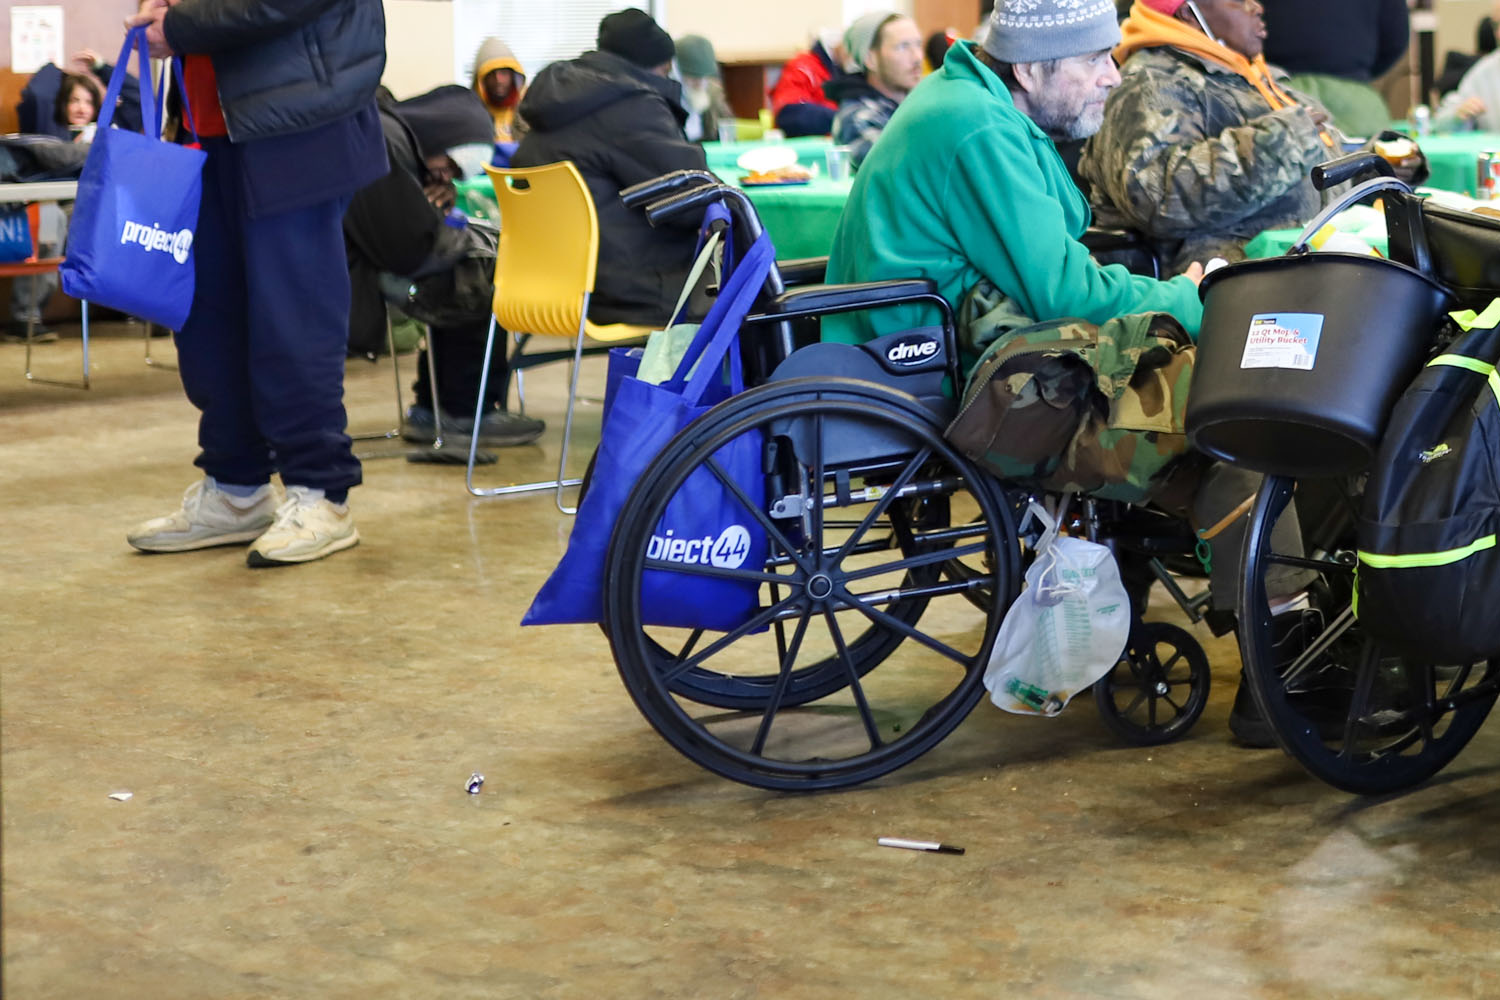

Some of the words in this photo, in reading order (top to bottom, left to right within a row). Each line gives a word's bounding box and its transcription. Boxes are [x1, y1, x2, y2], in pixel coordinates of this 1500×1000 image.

[1261, 329, 1271, 337] Qt
[1293, 328, 1300, 336] &
[1249, 336, 1275, 345] Utility
[1277, 336, 1307, 345] Bucket
[888, 341, 937, 361] drive
[646, 525, 751, 569] oject44
